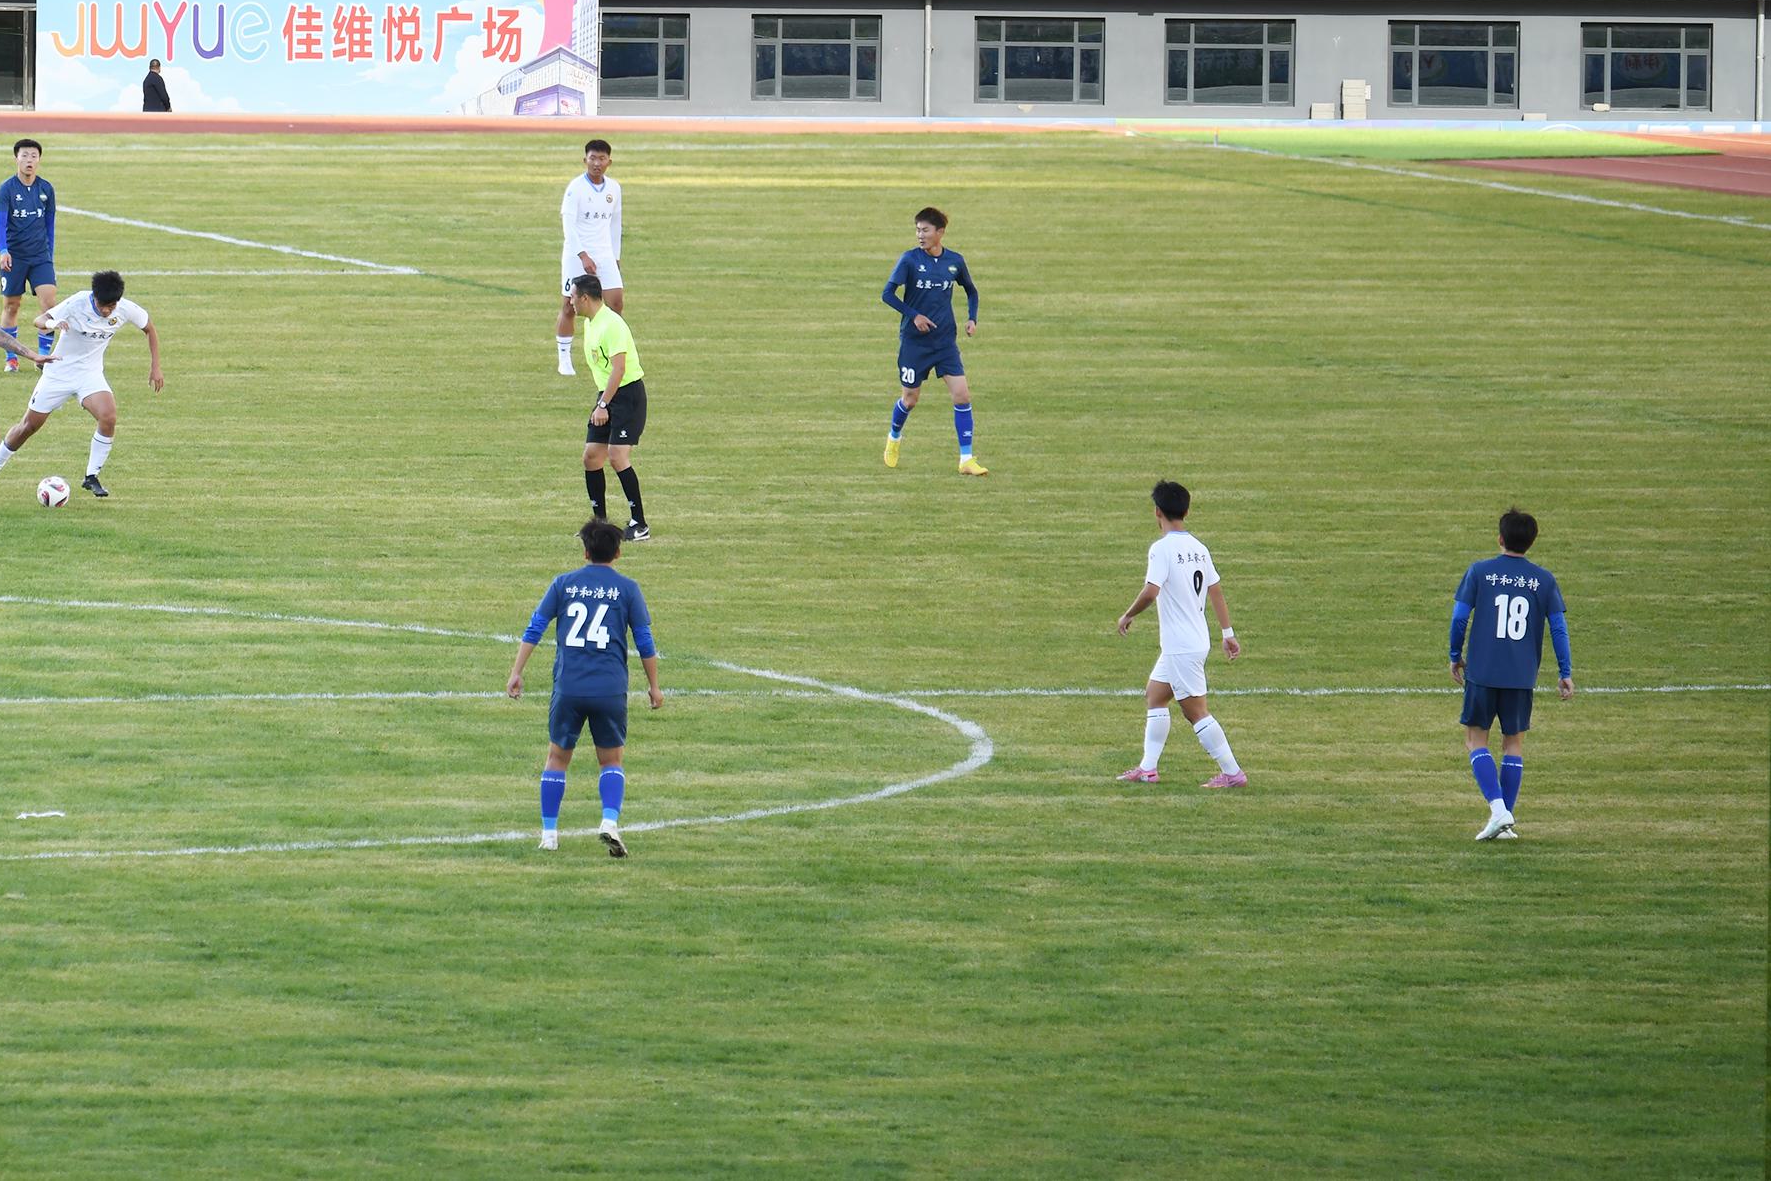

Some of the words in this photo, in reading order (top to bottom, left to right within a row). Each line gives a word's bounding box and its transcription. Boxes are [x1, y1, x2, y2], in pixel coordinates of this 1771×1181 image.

[282, 4, 523, 64] 佳维悦广场
[902, 366, 916, 384] 20
[565, 585, 621, 601] 呼和浩特
[1485, 572, 1541, 592] 呼和浩特
[565, 602, 610, 650] 24
[1494, 593, 1530, 641] 18
